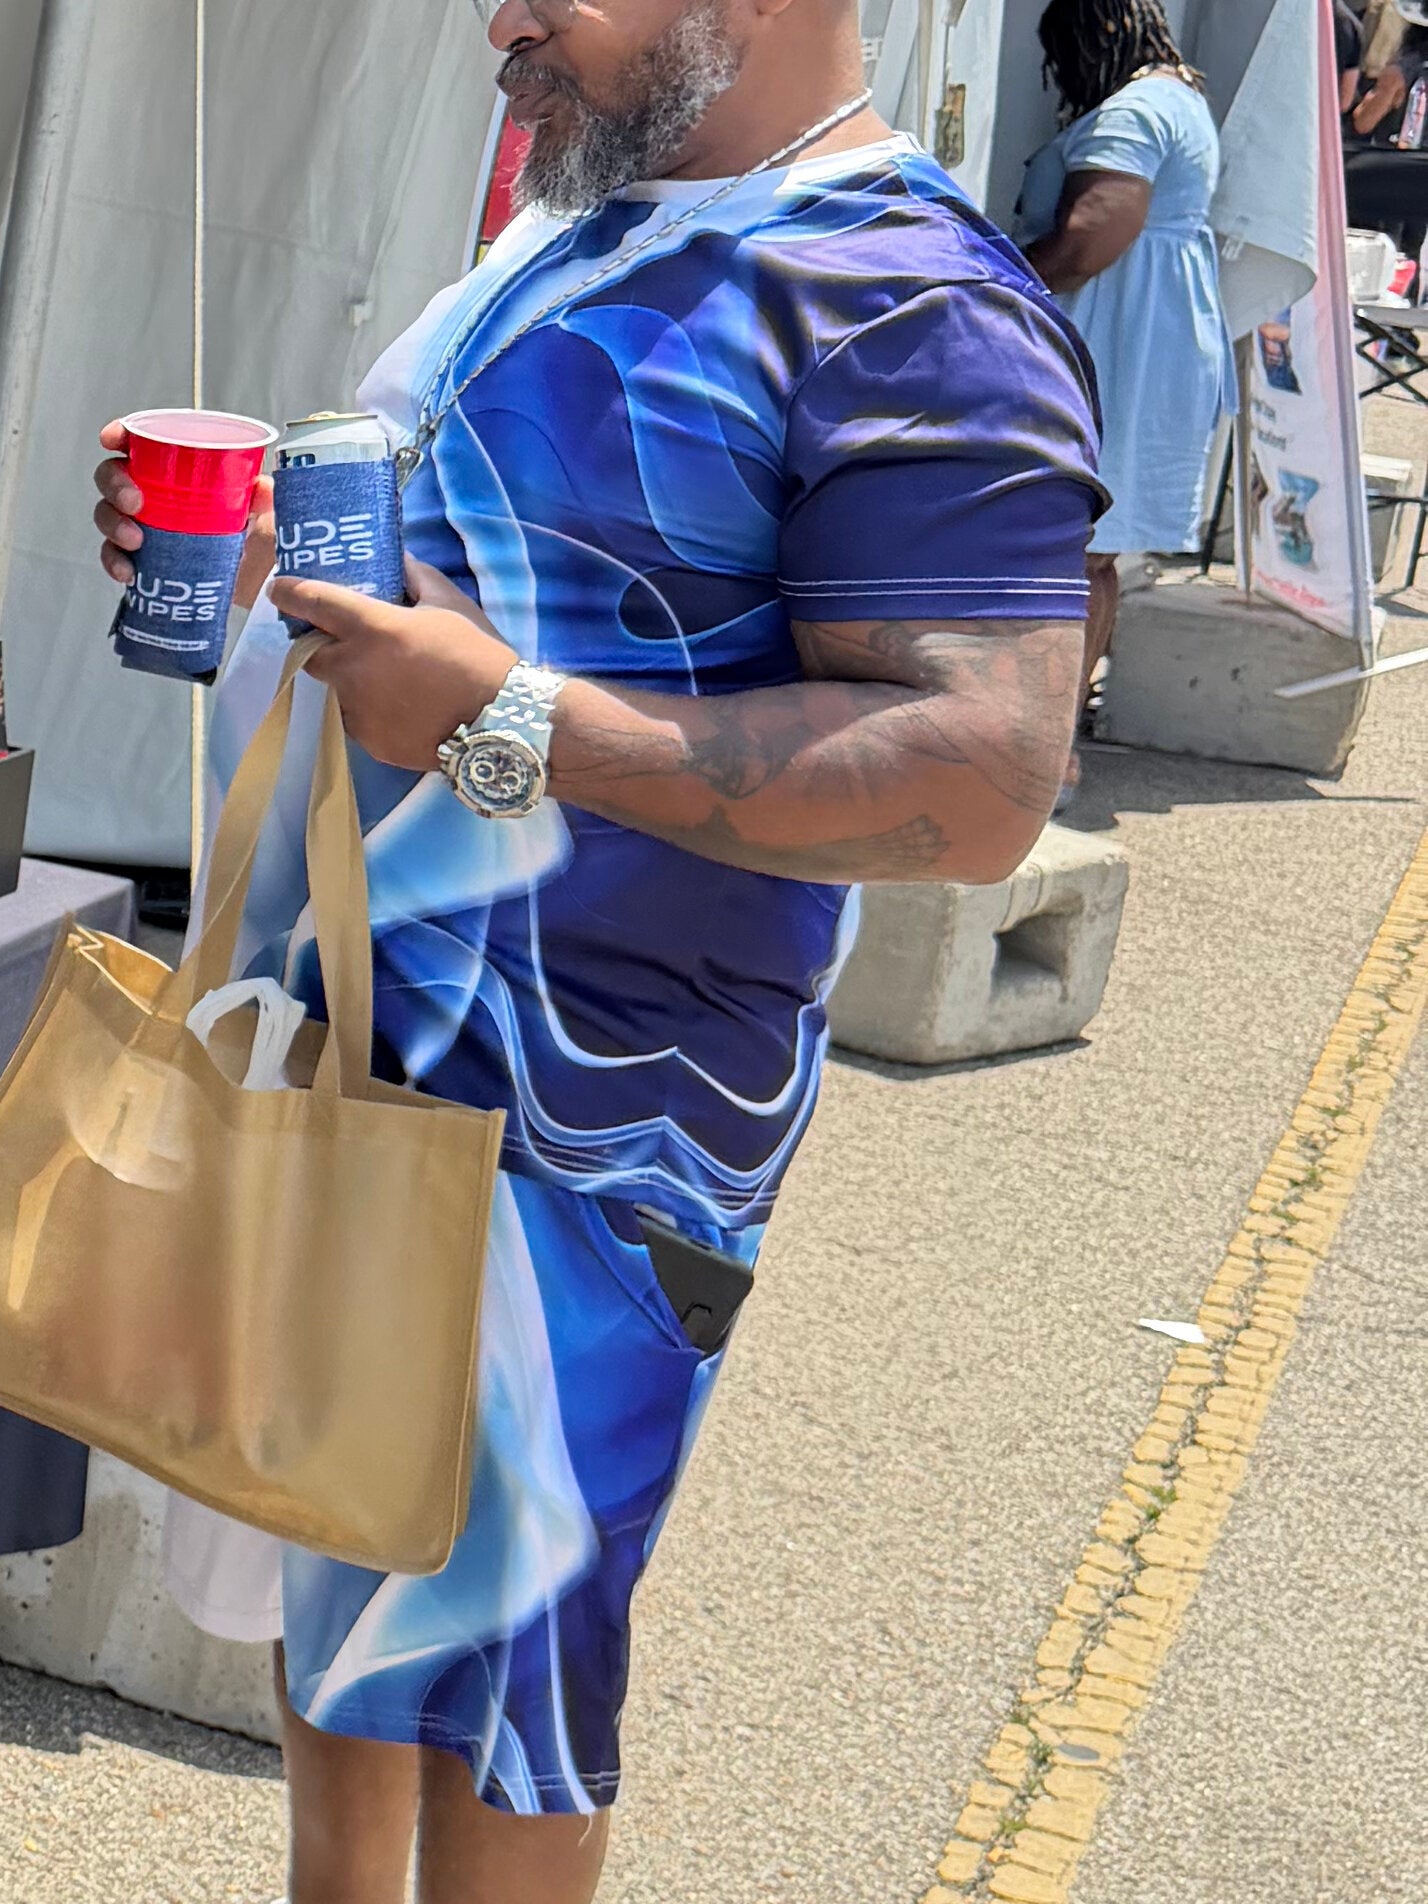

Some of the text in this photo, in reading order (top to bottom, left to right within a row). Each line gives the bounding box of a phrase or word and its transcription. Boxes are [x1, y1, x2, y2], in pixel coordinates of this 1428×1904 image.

[278, 513, 375, 551] UDE
[277, 541, 375, 572] IPES
[131, 571, 223, 604] UDE
